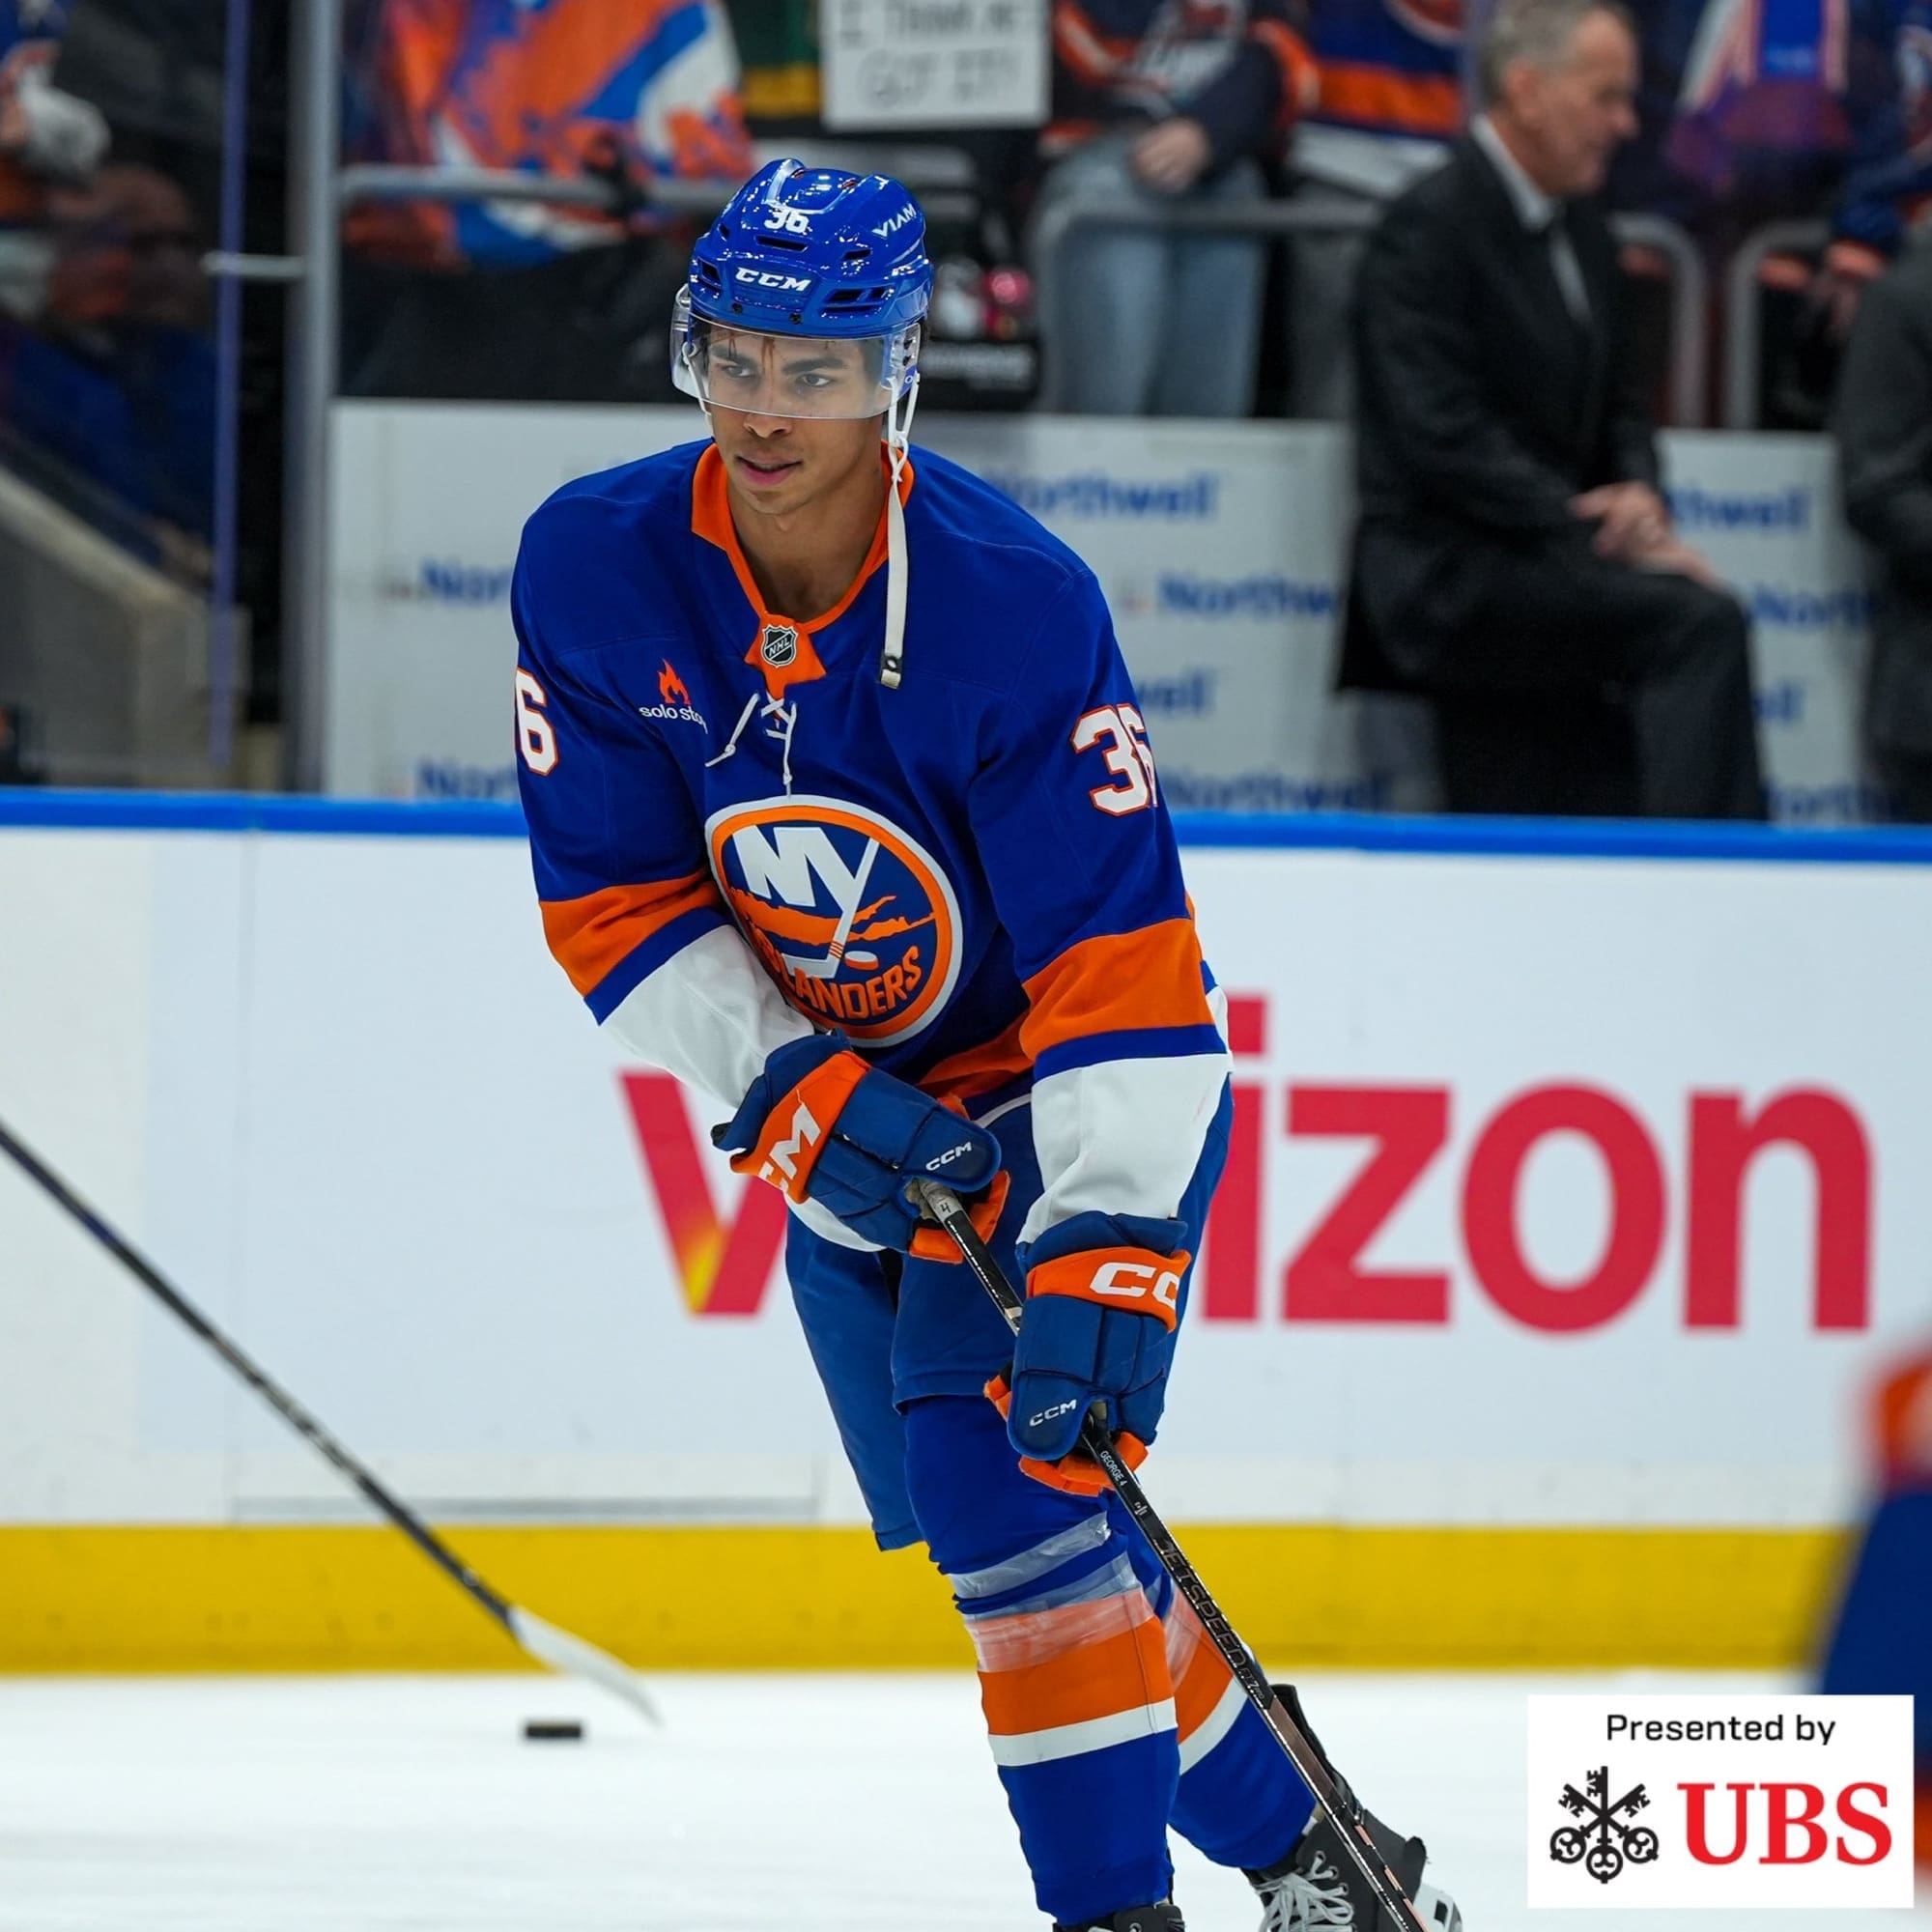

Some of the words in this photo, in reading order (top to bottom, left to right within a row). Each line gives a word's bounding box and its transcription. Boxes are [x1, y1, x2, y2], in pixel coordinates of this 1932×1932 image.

[764, 209, 810, 234] 36
[872, 203, 918, 240] VIAM
[734, 266, 811, 292] CCM
[768, 637, 791, 658] NHL
[639, 703, 678, 721] solo
[731, 824, 880, 932] NY
[616, 994, 1872, 1333] vizon
[925, 1141, 972, 1172] CCM
[1029, 1399, 1078, 1428] CCM
[1099, 1450, 1125, 1482] GEORGE
